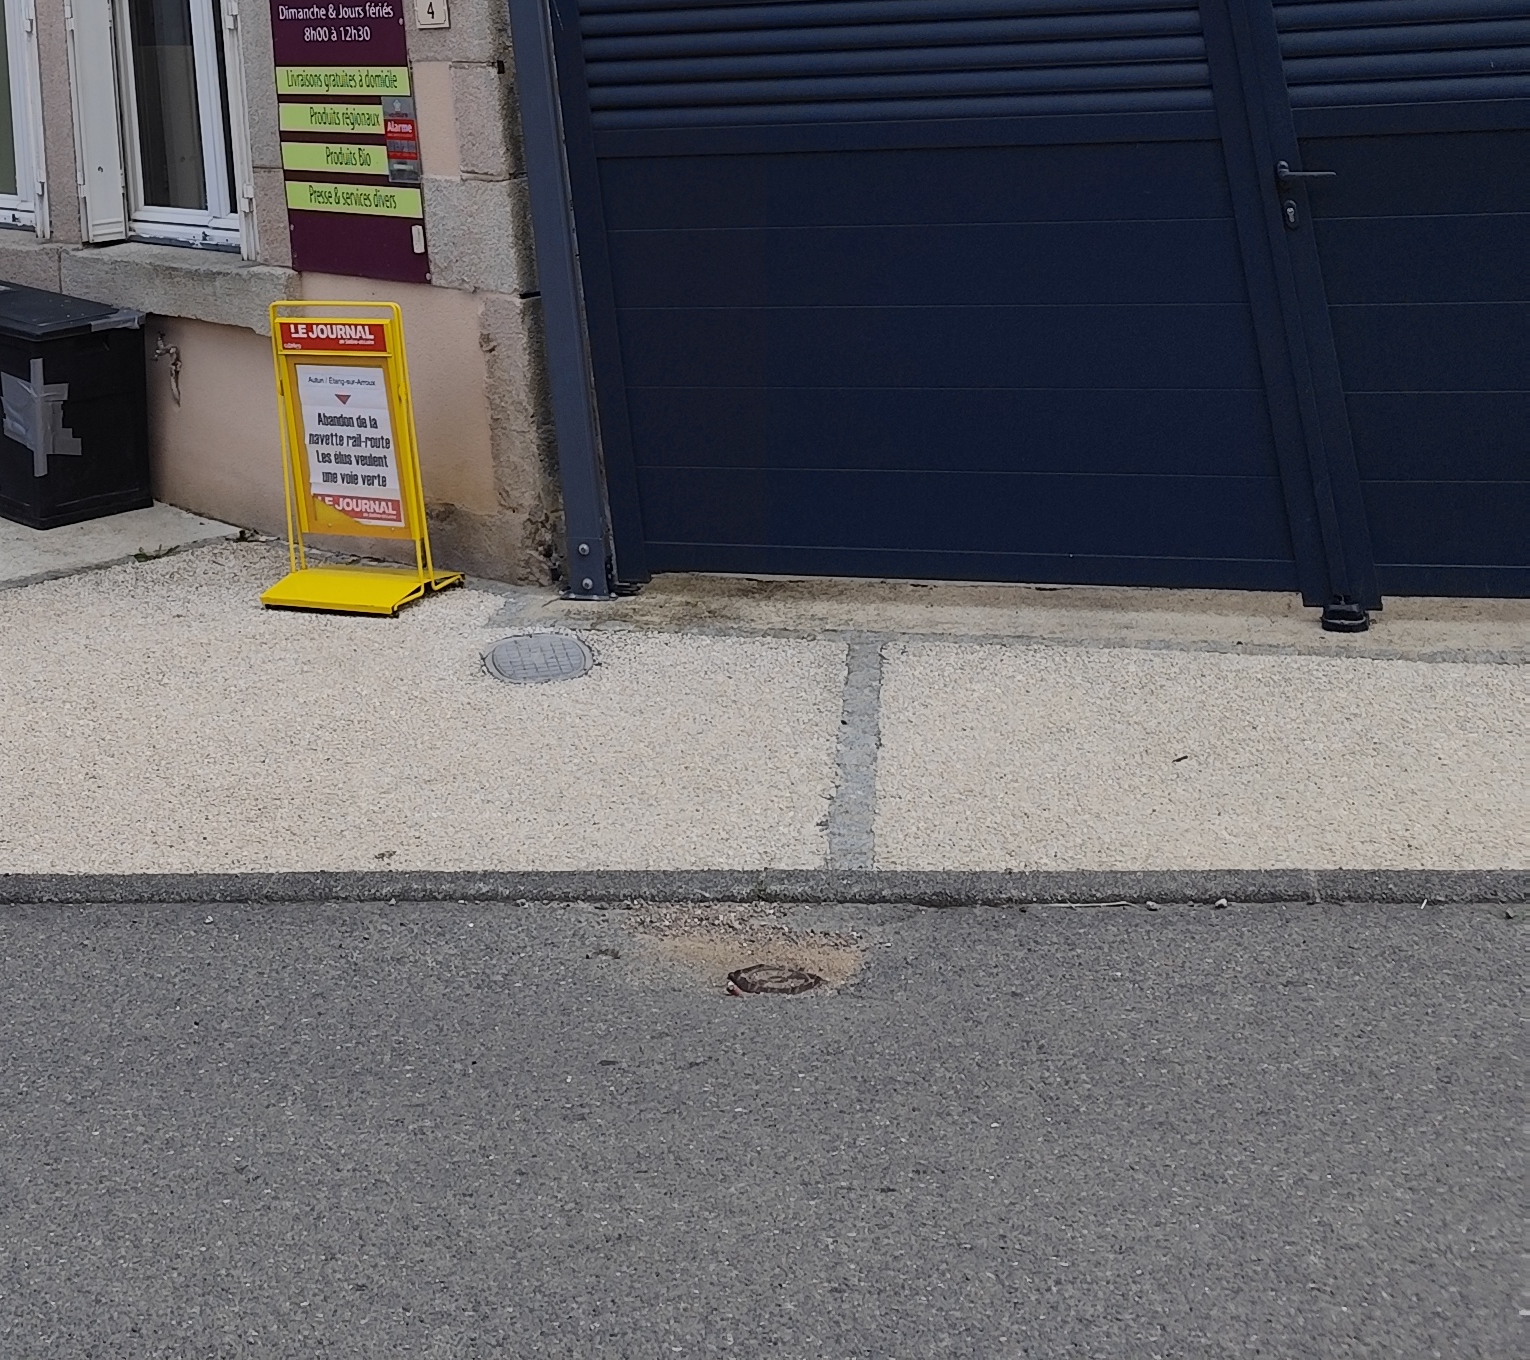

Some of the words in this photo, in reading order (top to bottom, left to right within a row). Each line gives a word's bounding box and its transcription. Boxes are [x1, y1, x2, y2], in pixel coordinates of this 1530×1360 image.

[279, 5, 326, 20] Dimanche
[328, 3, 336, 19] &
[338, 4, 364, 18] Jours
[365, 2, 393, 18] fériés
[427, 2, 434, 19] 4
[304, 27, 329, 41] 8h00
[331, 26, 337, 41] à
[339, 26, 370, 40] 12h30
[286, 70, 323, 87] Livraisons
[324, 70, 357, 92] gratuites
[358, 70, 364, 88] à
[365, 69, 398, 89] domicile
[310, 107, 340, 126] Produits
[342, 108, 380, 130] régionaux
[387, 121, 413, 133] Alarme
[326, 146, 357, 166] Produits
[358, 148, 372, 166] Bio
[309, 185, 332, 205] Presse
[334, 186, 341, 205] &
[342, 188, 373, 208] services
[374, 189, 397, 209] divers
[290, 324, 308, 338] LE
[309, 325, 374, 340] JOURNAL
[317, 413, 355, 428] Abandon
[357, 415, 368, 429] de
[369, 416, 378, 429] la
[309, 433, 345, 447] navette
[346, 433, 391, 449] rail-route
[316, 450, 332, 463] Les
[334, 451, 352, 465] élus
[354, 453, 389, 468] veulent
[322, 471, 337, 483] une
[340, 471, 359, 485] voie
[361, 473, 387, 488] verte
[334, 497, 397, 515] JOURNAL
